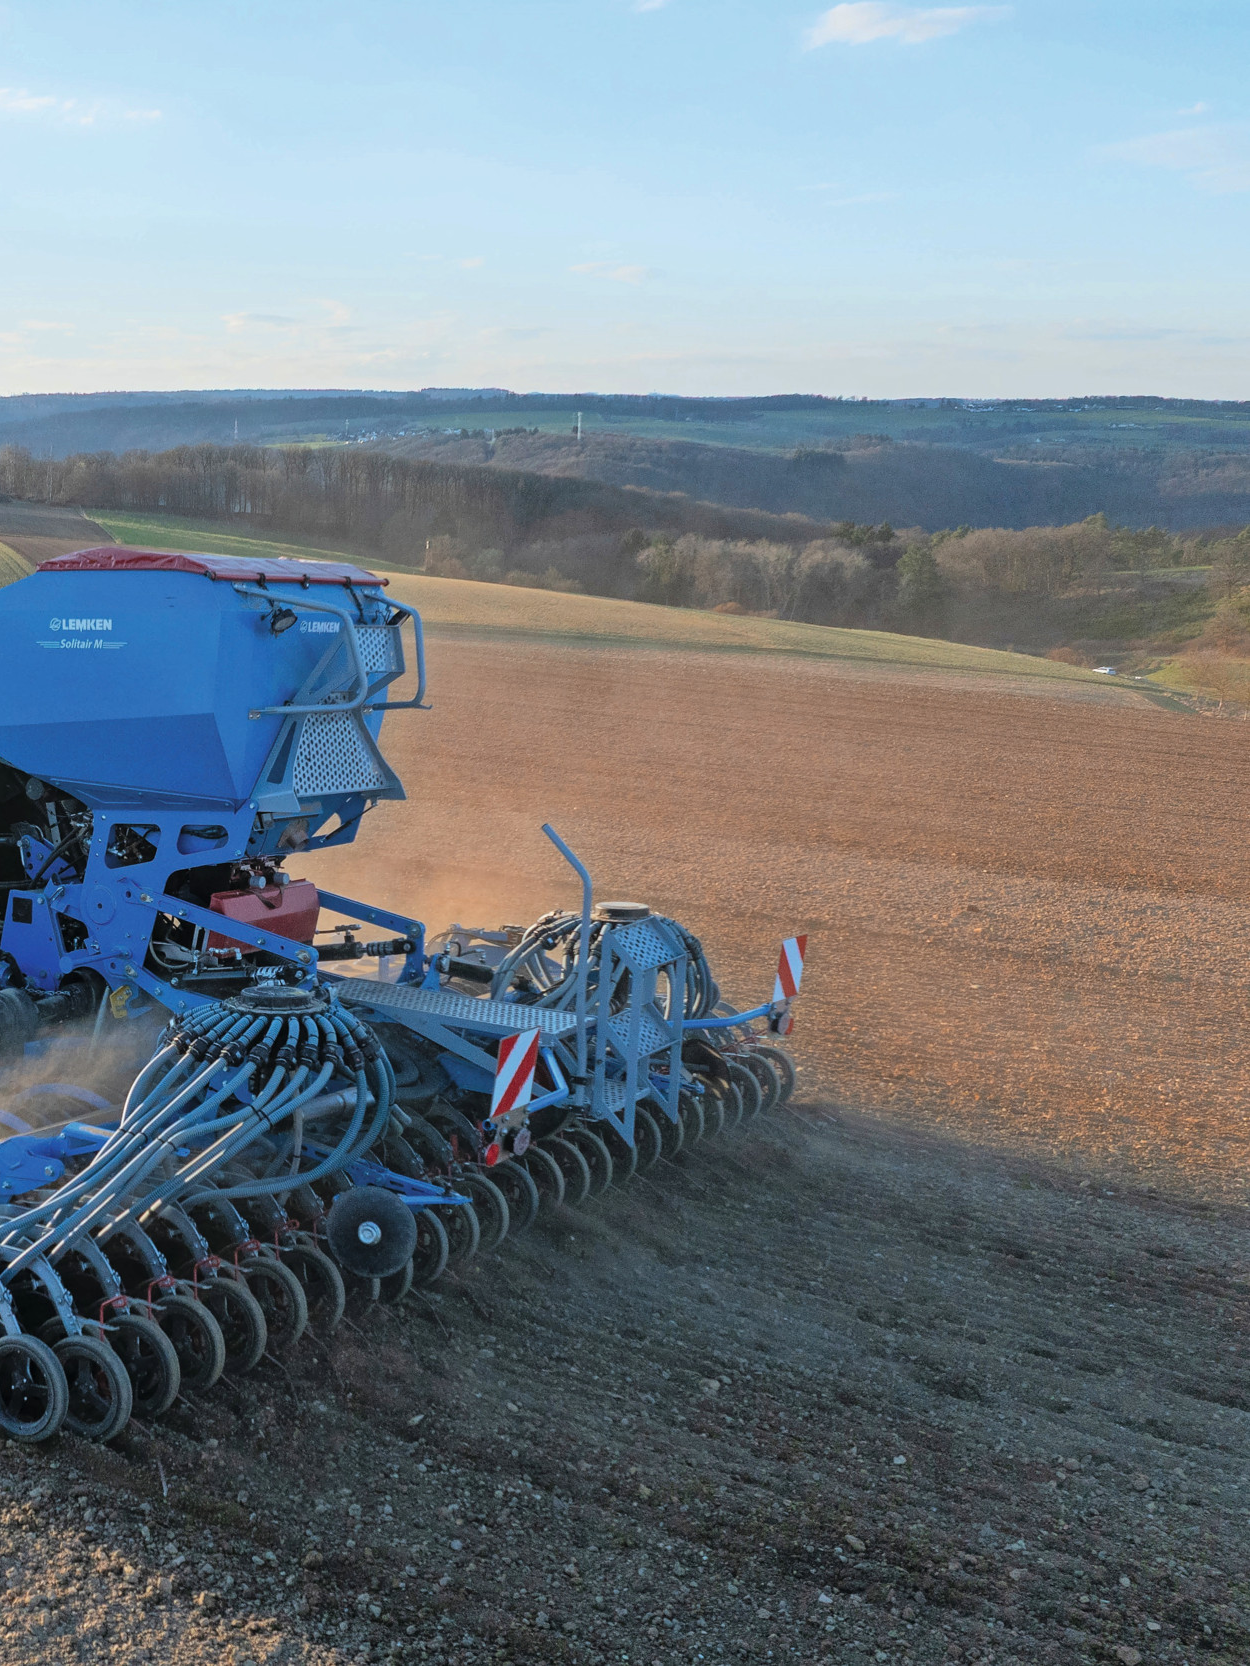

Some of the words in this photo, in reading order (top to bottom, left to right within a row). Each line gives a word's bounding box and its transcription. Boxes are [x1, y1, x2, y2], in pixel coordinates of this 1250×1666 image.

[62, 618, 113, 632] LEMKEN
[307, 620, 341, 635] LEMKEN
[60, 638, 93, 650] Solitair
[93, 638, 104, 650] M
